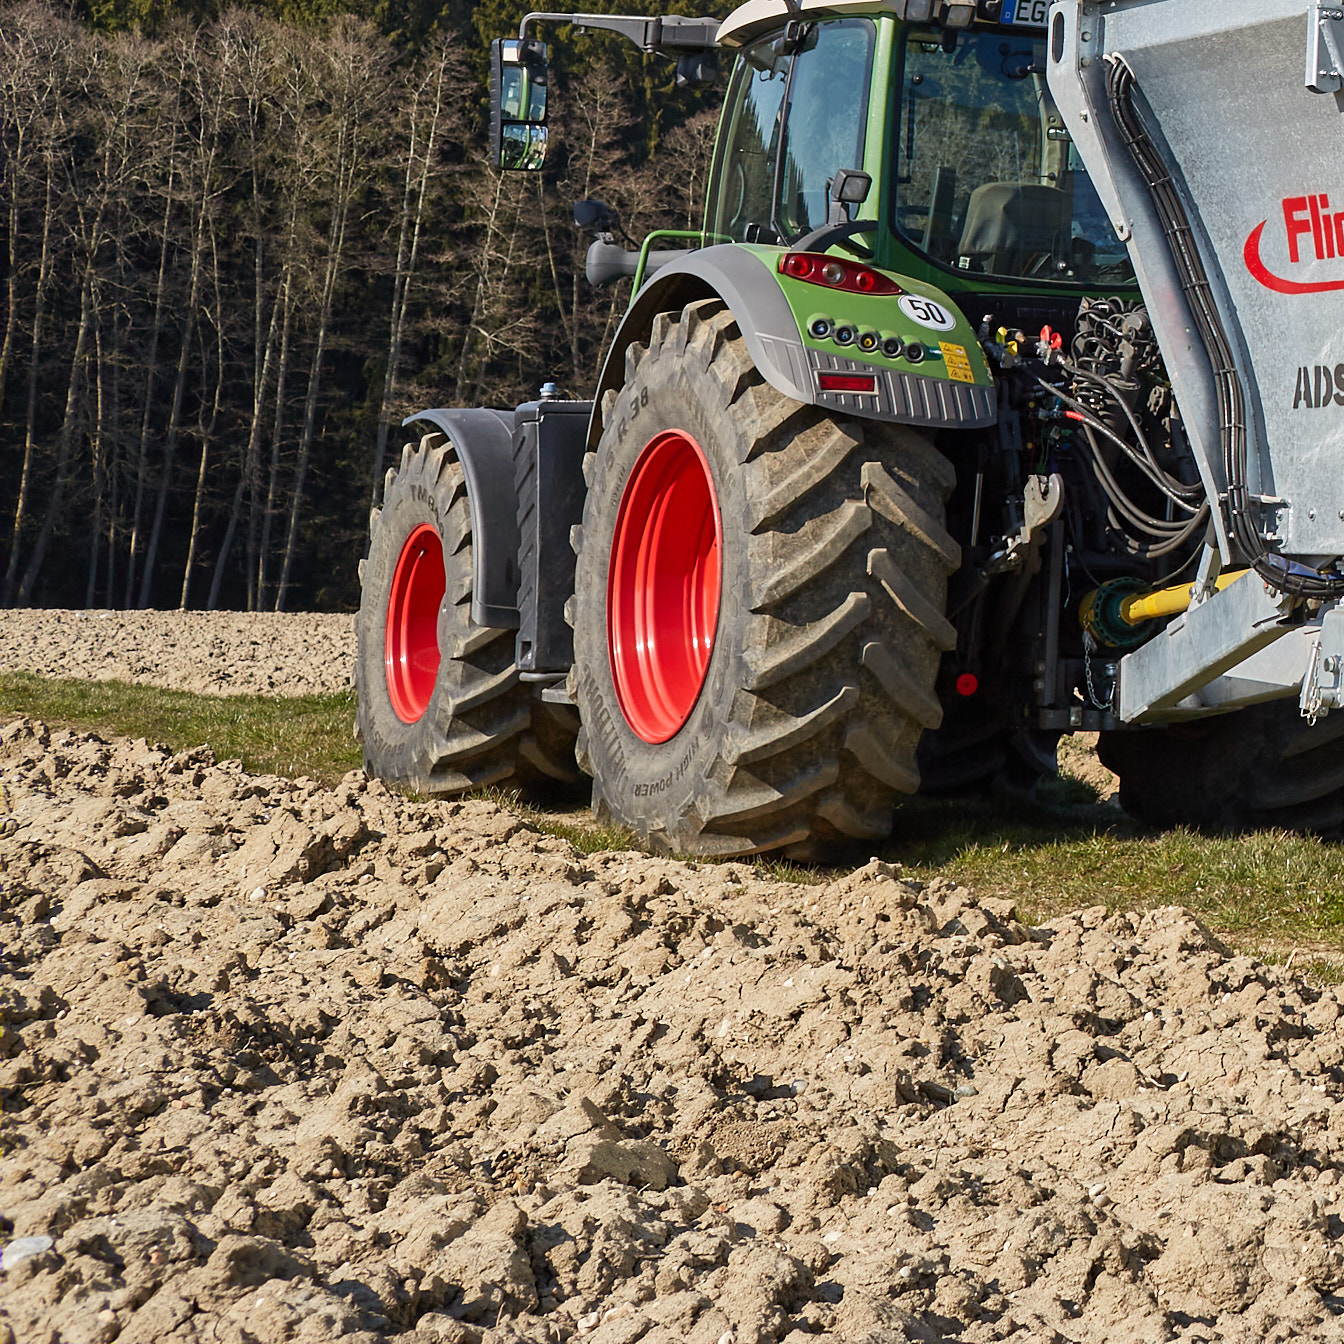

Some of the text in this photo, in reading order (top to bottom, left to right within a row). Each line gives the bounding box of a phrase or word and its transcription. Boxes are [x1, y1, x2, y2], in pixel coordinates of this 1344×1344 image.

[907, 298, 946, 325] 50
[633, 735, 700, 797] HIGH POWER
